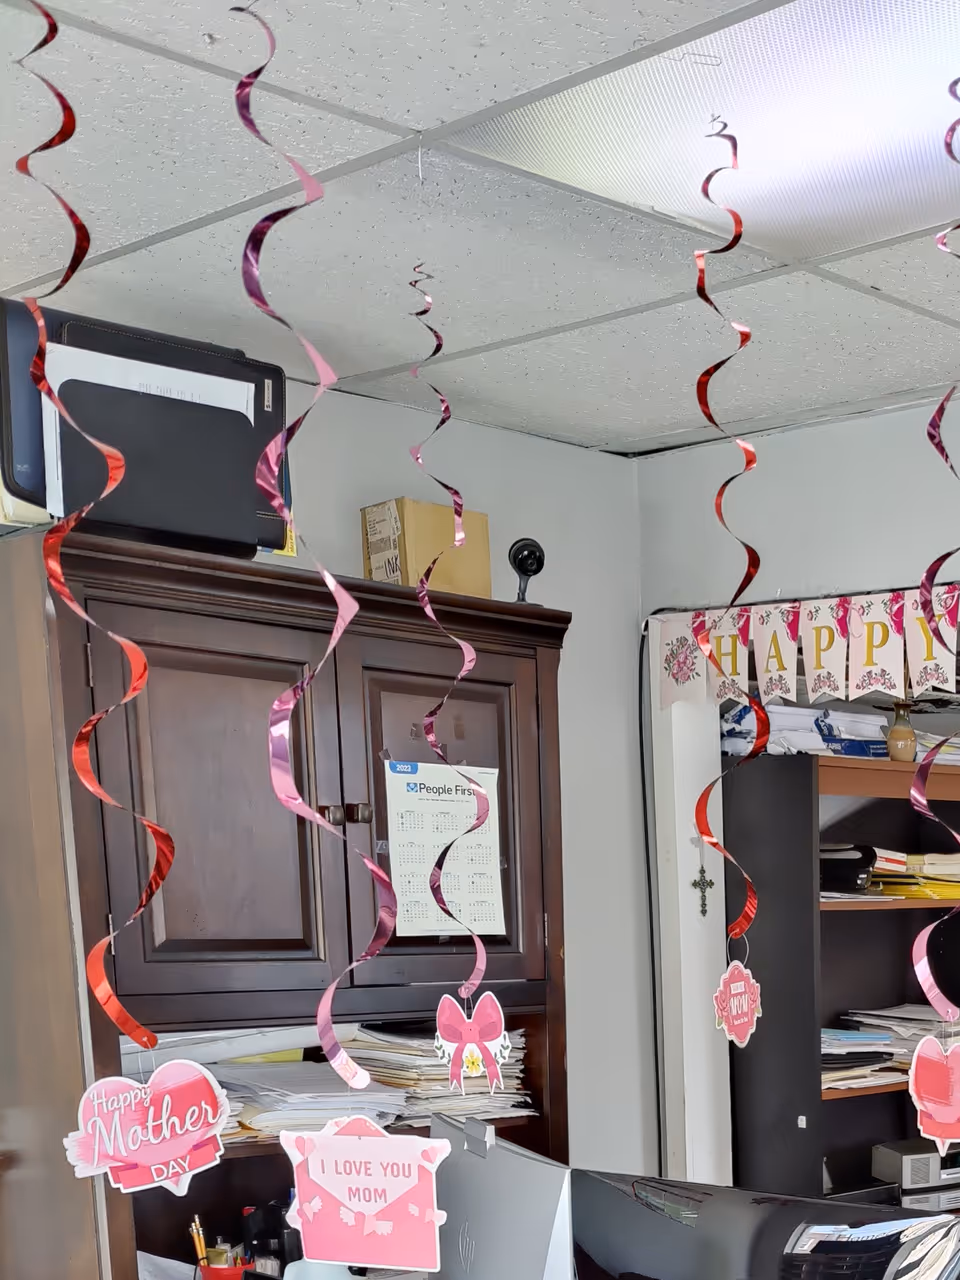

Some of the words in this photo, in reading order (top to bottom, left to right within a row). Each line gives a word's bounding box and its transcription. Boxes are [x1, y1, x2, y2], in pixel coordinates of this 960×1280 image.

[713, 612, 946, 677] HAPPY
[419, 782, 454, 797] People
[90, 1084, 153, 1112] Happy
[87, 1095, 222, 1167] Mother
[151, 1155, 192, 1182] DAY
[321, 1159, 326, 1174] I
[334, 1159, 373, 1177] LOVE
[379, 1160, 413, 1179] YOU
[347, 1186, 388, 1204] MOM
